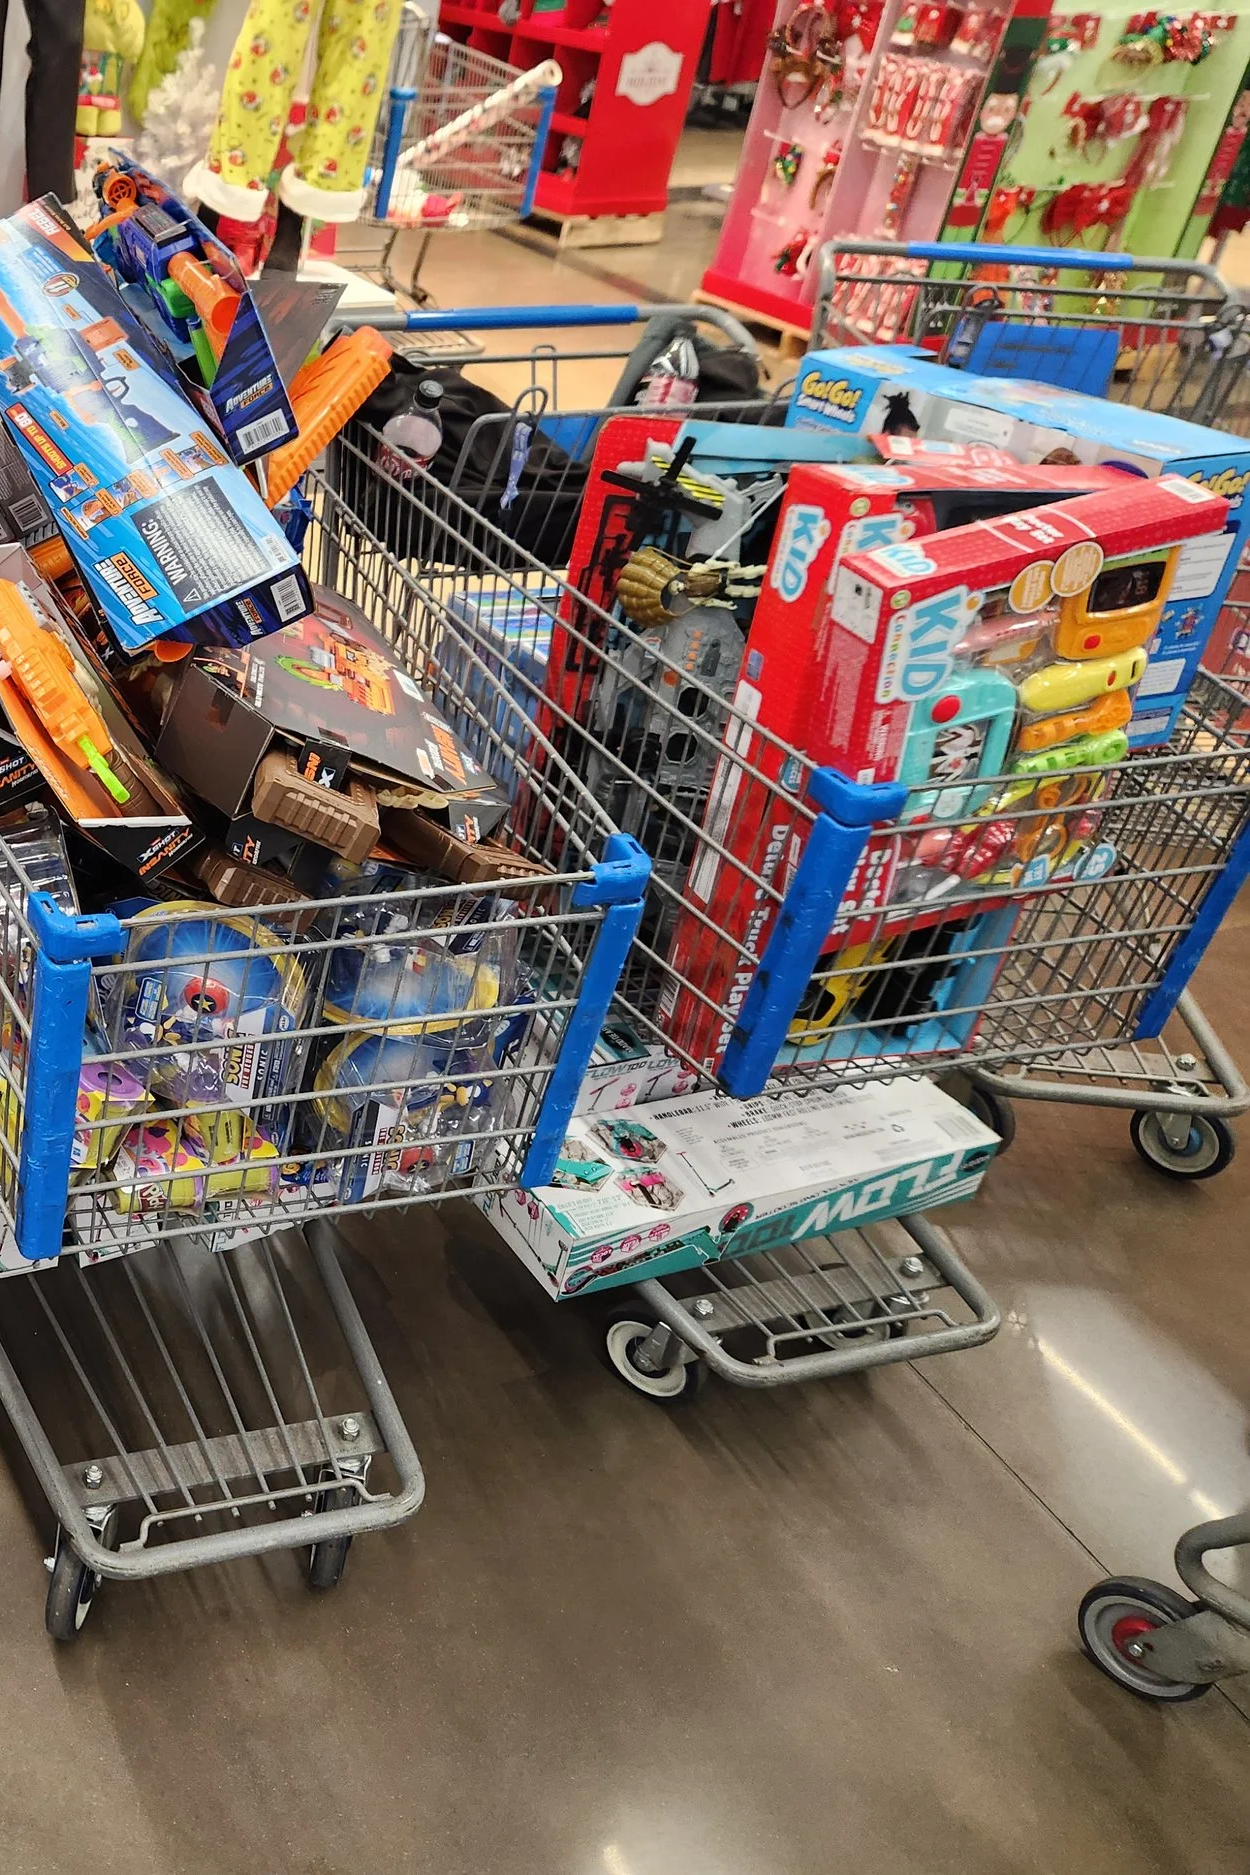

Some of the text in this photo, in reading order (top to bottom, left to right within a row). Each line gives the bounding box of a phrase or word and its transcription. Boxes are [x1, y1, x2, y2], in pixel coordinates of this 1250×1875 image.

[225, 373, 273, 413] ADVENTURE
[34, 433, 47, 448] UP
[41, 444, 67, 470] SHOOTS
[115, 557, 151, 595] FORCE
[141, 518, 186, 586] WARNING:
[782, 511, 819, 599] KID
[94, 559, 164, 626] ADVENTURE
[902, 592, 963, 696] KID
[136, 827, 180, 864] XSHOT
[138, 827, 191, 877] INSANITY
[857, 848, 892, 922] Doctor
[738, 906, 770, 966] Truck
[715, 972, 753, 1055] Playset
[256, 1049, 268, 1081] SONIC
[627, 1060, 648, 1072] 100
[730, 1117, 761, 1129] WHEELS:
[791, 1150, 963, 1241] FLOW
